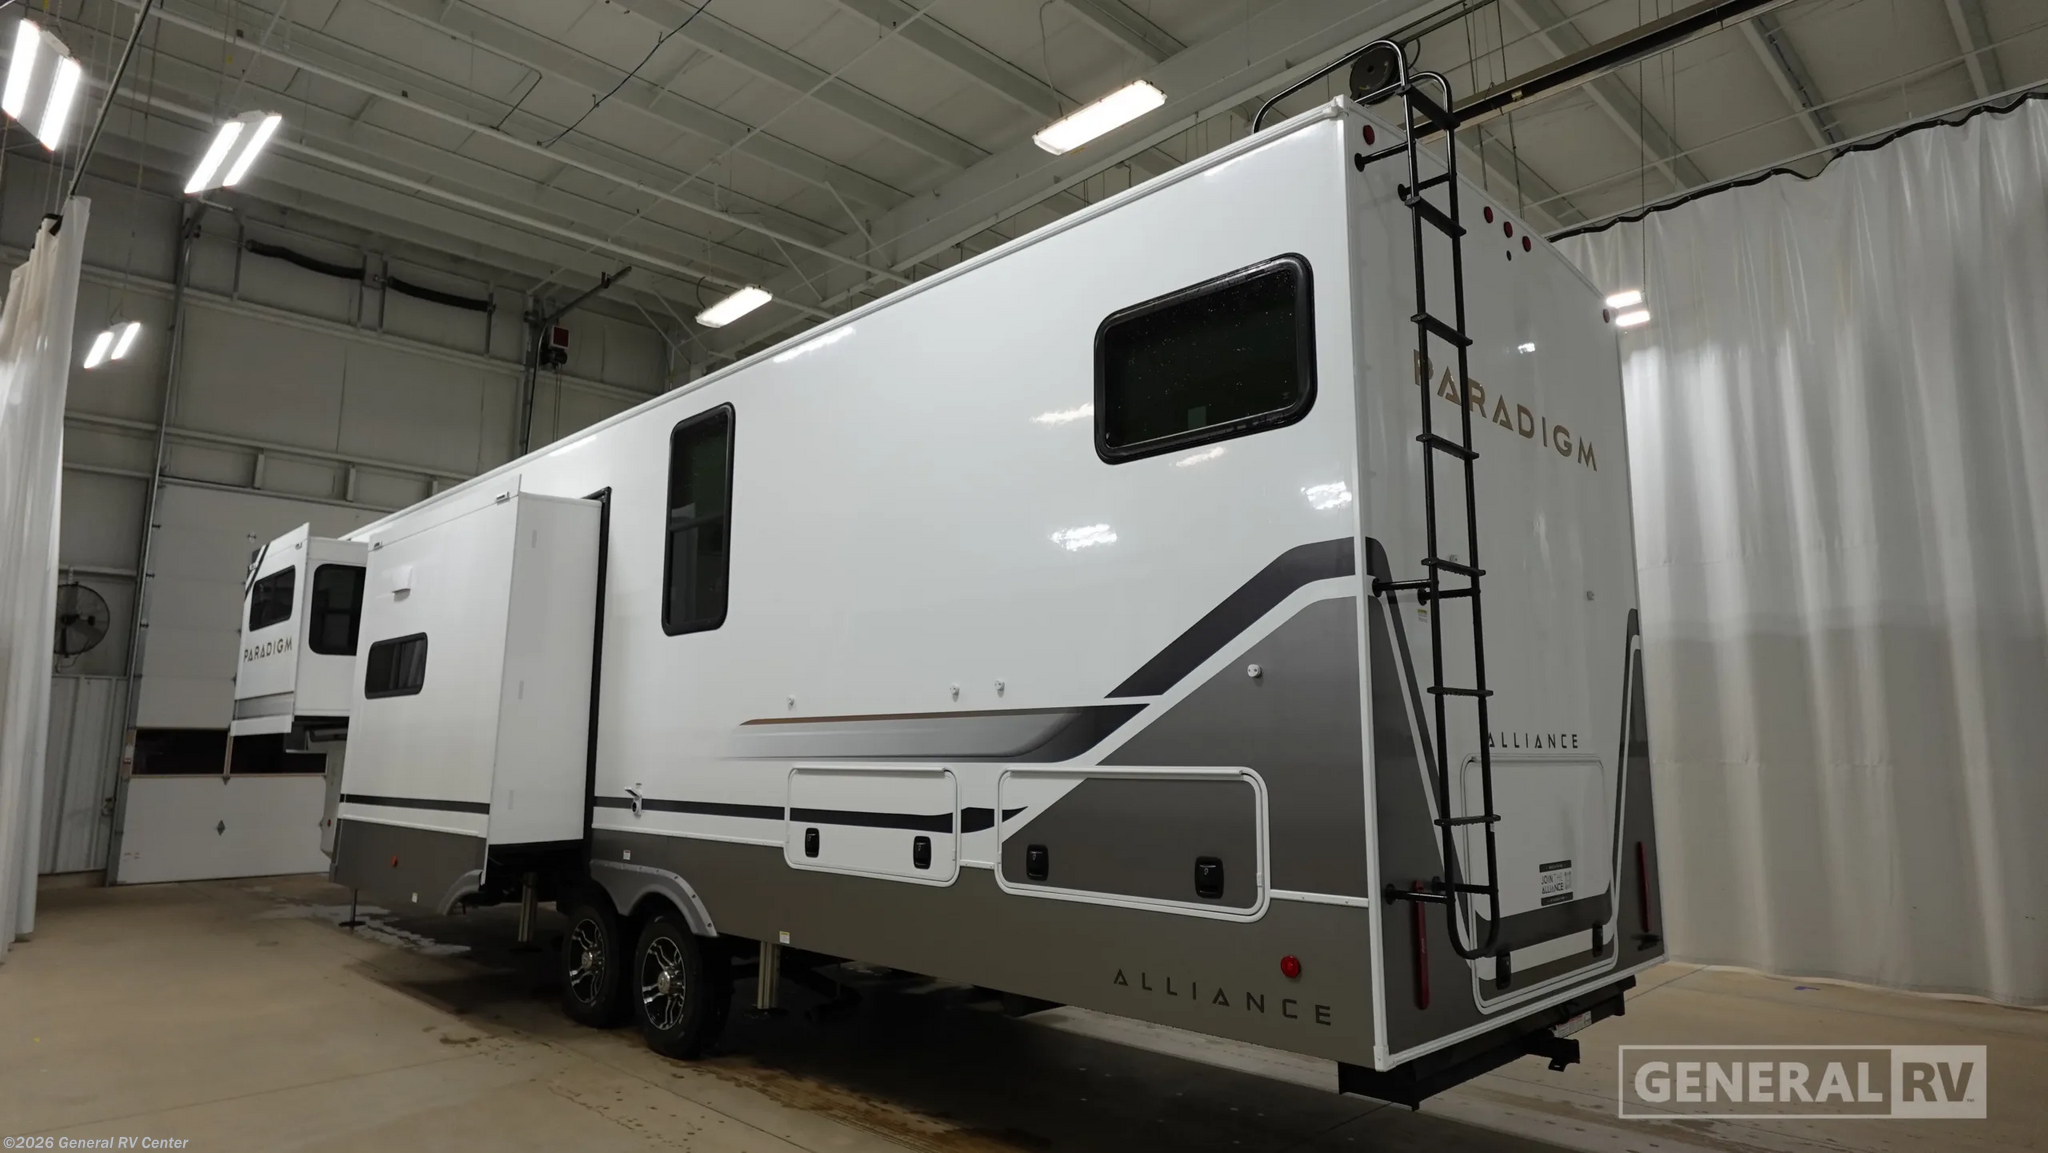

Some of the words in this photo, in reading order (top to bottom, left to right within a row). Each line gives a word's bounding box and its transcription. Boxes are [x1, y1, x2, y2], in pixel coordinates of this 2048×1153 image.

[1413, 348, 1598, 472] PARADIGM
[243, 636, 293, 663] PARADIGM
[1487, 731, 1579, 749] ALLIANCE
[1541, 875, 1553, 885] JOIN
[1541, 882, 1564, 894] ALLIANCE
[1113, 968, 1332, 1026] ALLIANCE
